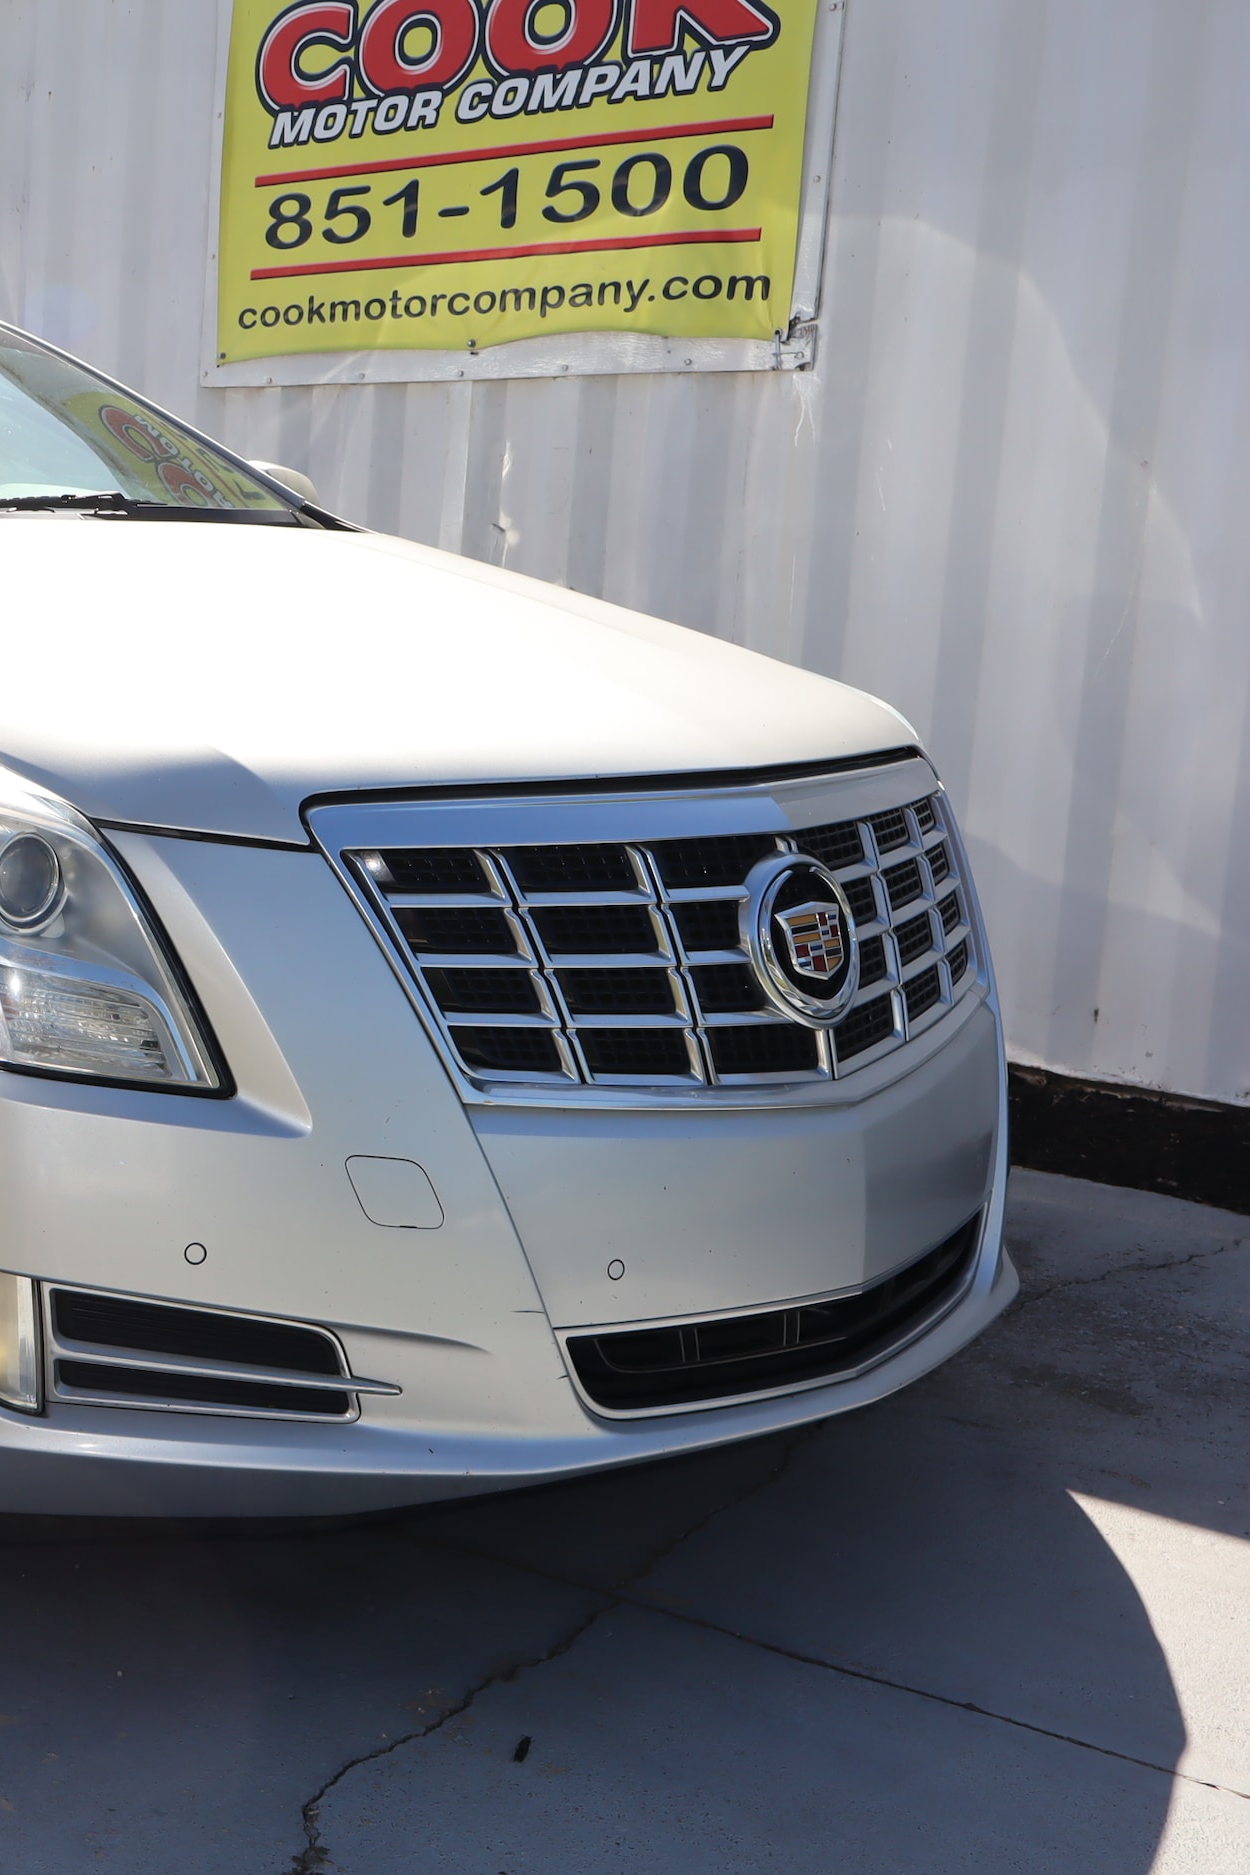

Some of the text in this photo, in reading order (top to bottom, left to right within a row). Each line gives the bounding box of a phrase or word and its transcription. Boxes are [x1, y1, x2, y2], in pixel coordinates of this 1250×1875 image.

[267, 44, 751, 148] MOTOR COMPANY
[264, 143, 750, 250] 851-1500
[237, 271, 771, 330] cookmotorcompany.com
